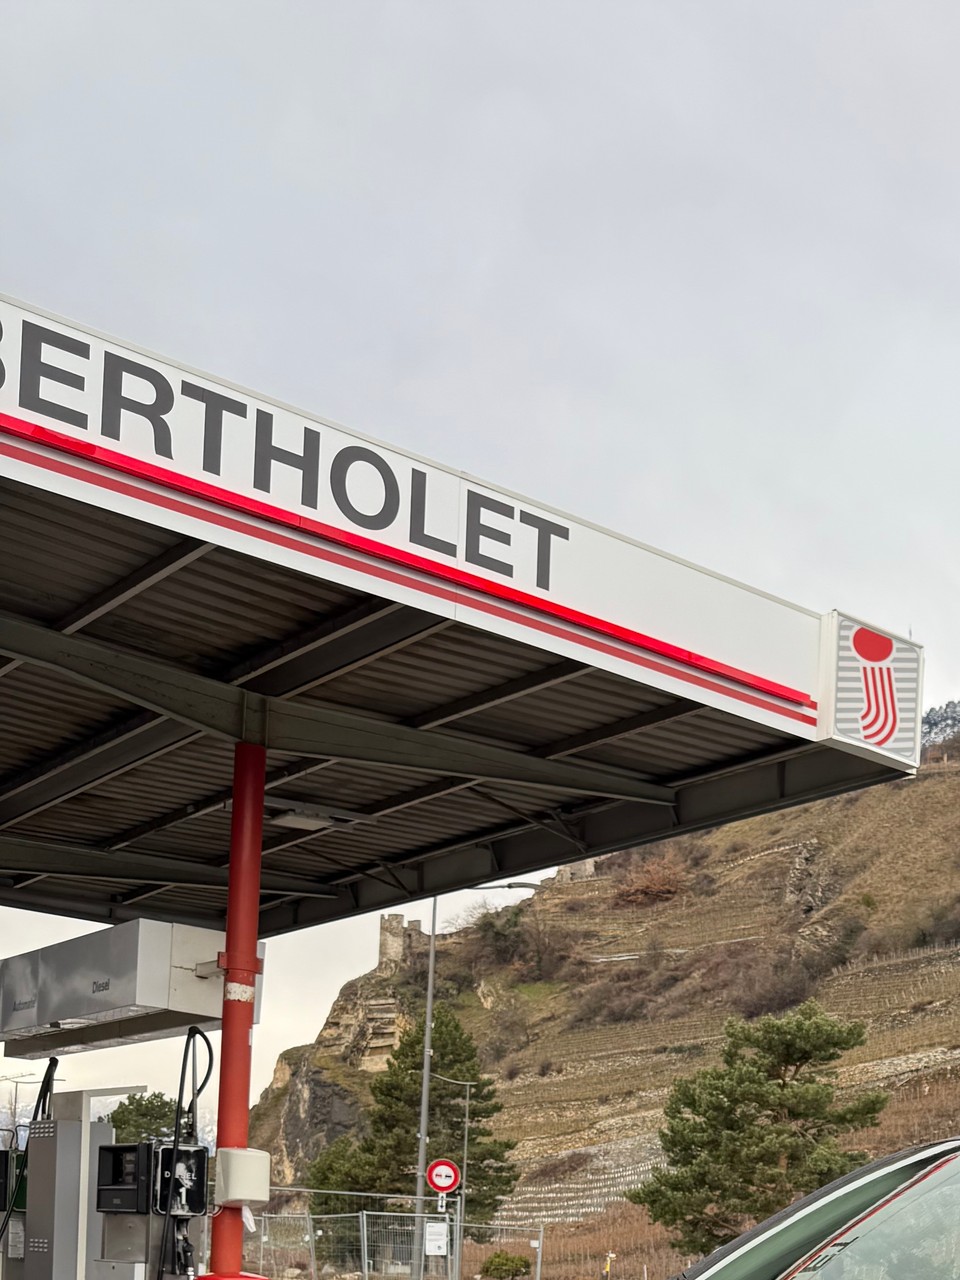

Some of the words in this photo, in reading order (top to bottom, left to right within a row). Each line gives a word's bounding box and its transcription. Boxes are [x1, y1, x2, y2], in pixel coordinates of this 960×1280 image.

[0, 319, 569, 591] ERTHOLET
[92, 978, 110, 994] Diesel
[179, 1187, 187, 1205] 1
